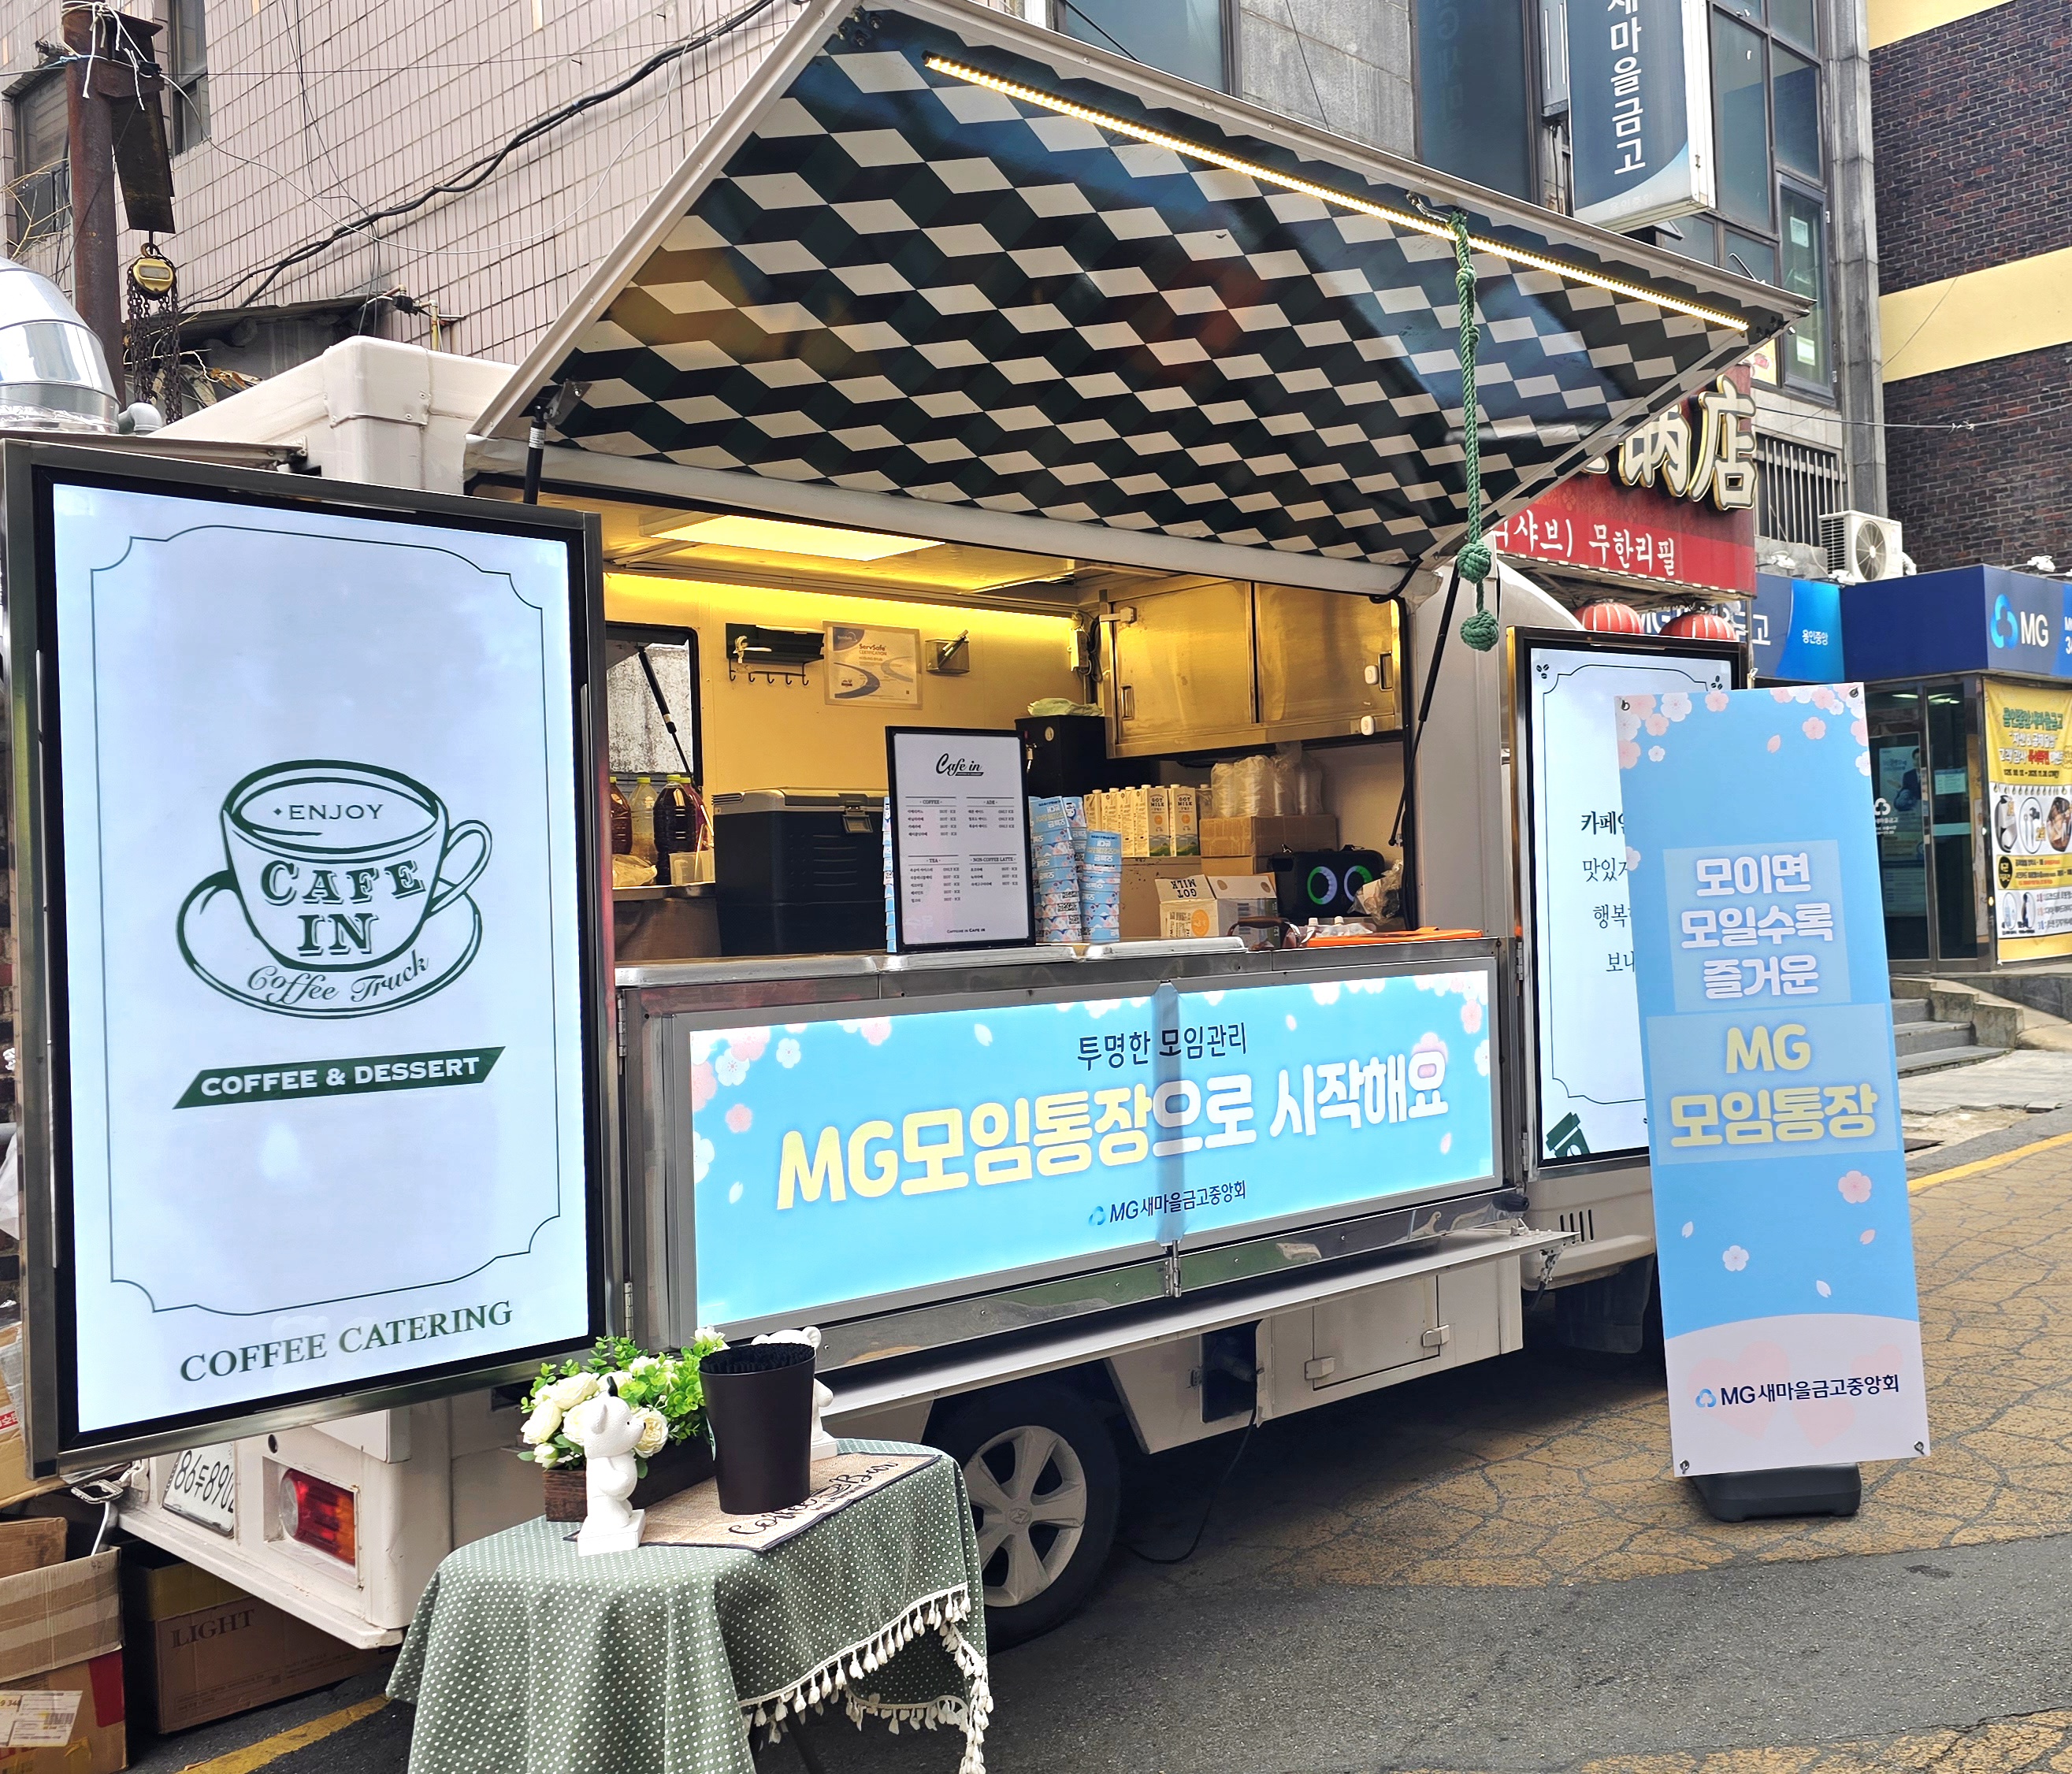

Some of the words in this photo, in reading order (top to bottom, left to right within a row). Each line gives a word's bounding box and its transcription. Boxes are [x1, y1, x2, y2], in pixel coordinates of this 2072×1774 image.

[1588, 524, 1675, 577] 무한리필
[1802, 629, 1829, 646] 용인중앙
[2020, 611, 2049, 648] MG
[936, 752, 967, 776] Cafe
[968, 760, 982, 771] in
[288, 803, 384, 820] ENJOY
[260, 859, 427, 906] CAFE
[1170, 878, 1197, 889] MILK
[1177, 888, 1197, 899] GOT
[1695, 852, 1811, 896] 모이면
[296, 912, 379, 956] IN
[1593, 904, 1632, 930] 행복
[1681, 903, 1834, 948] 모일수록
[247, 965, 339, 1004] Coffee
[350, 949, 429, 1003] Truck
[1703, 955, 1819, 999] 즐거운
[1078, 1030, 1151, 1071] 투명한
[1159, 1022, 1247, 1060] 모임관리
[1725, 1023, 1811, 1074] MG
[200, 1070, 317, 1097] COFFEE
[326, 1068, 347, 1086] &
[354, 1056, 480, 1085] DESSERT
[777, 1073, 1257, 1211] MG모임통장으로
[1269, 1051, 1450, 1138] 시작해요
[1670, 1083, 1878, 1148] 모임통장
[180, 1333, 329, 1382] COFFEE
[338, 1300, 513, 1354] CATERING
[170, 1609, 254, 1649] LIGHT
